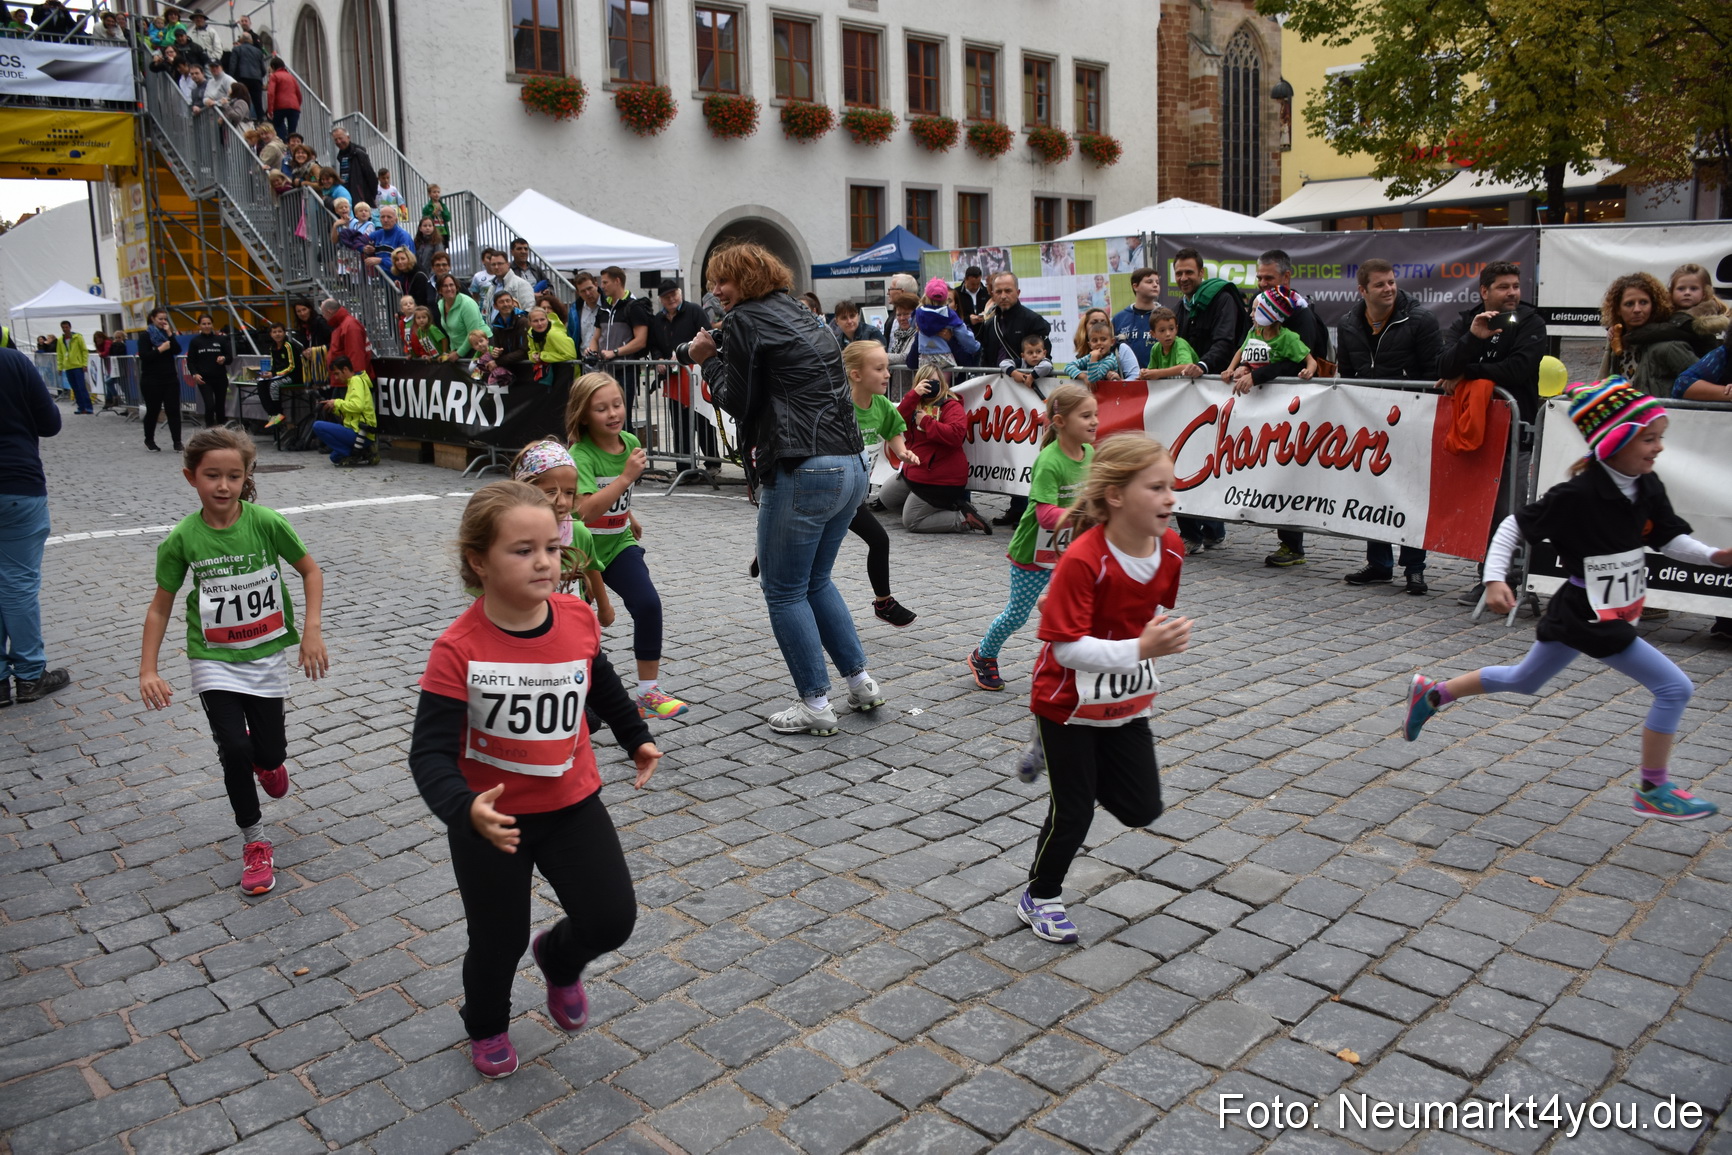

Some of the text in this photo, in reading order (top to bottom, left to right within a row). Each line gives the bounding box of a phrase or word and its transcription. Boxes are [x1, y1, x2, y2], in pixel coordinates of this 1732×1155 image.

[18, 138, 111, 148] Neumarkter Stadtlauf
[830, 266, 860, 275] Neumarkter
[1551, 312, 1600, 323] Leistungen
[1167, 396, 1402, 492] Charivari
[1224, 485, 1406, 529] Ostbayerns Radio
[190, 553, 244, 570] Neumarkter
[1587, 562, 1619, 573] PARTL
[1659, 566, 1688, 583] die
[202, 577, 269, 594] PARTL Neumarkt
[209, 584, 276, 625] 7194
[227, 623, 268, 641] Antonia
[471, 674, 571, 687] PARTL Neumarkt
[481, 690, 579, 735] 7500
